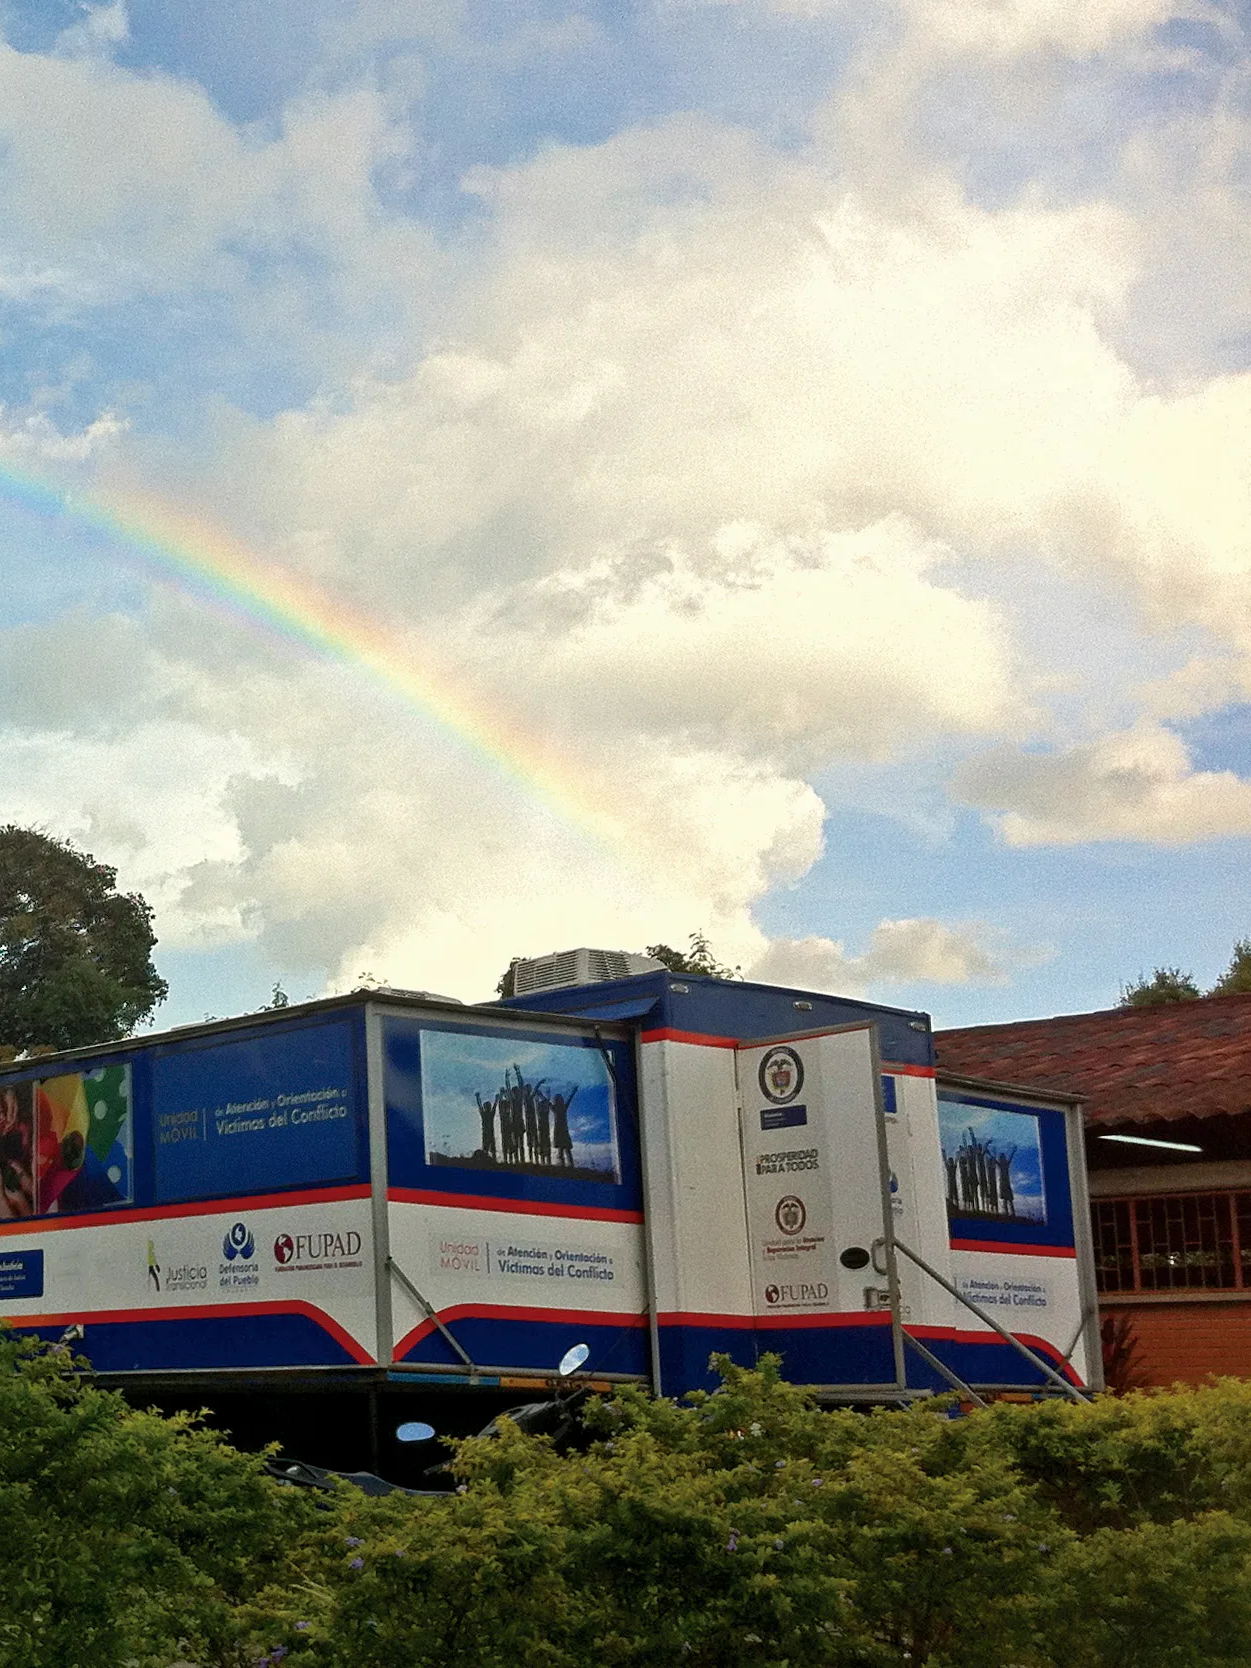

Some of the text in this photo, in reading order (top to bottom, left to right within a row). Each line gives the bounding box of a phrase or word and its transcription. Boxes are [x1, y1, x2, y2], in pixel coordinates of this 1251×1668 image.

[226, 1098, 269, 1115] Atención
[277, 1086, 340, 1107] Orientación
[216, 1104, 347, 1135] Víctimas del Conflicto
[786, 1159, 819, 1172] TODOS
[296, 1231, 361, 1259] FUPAD
[440, 1241, 478, 1256] Unidad
[507, 1246, 547, 1260] Atención
[554, 1250, 607, 1265] Orientación
[166, 1264, 207, 1284] Justicia
[498, 1259, 614, 1281] Víctimas del Conflicto
[781, 1283, 828, 1300] FUPAD
[999, 1294, 1011, 1304] del
